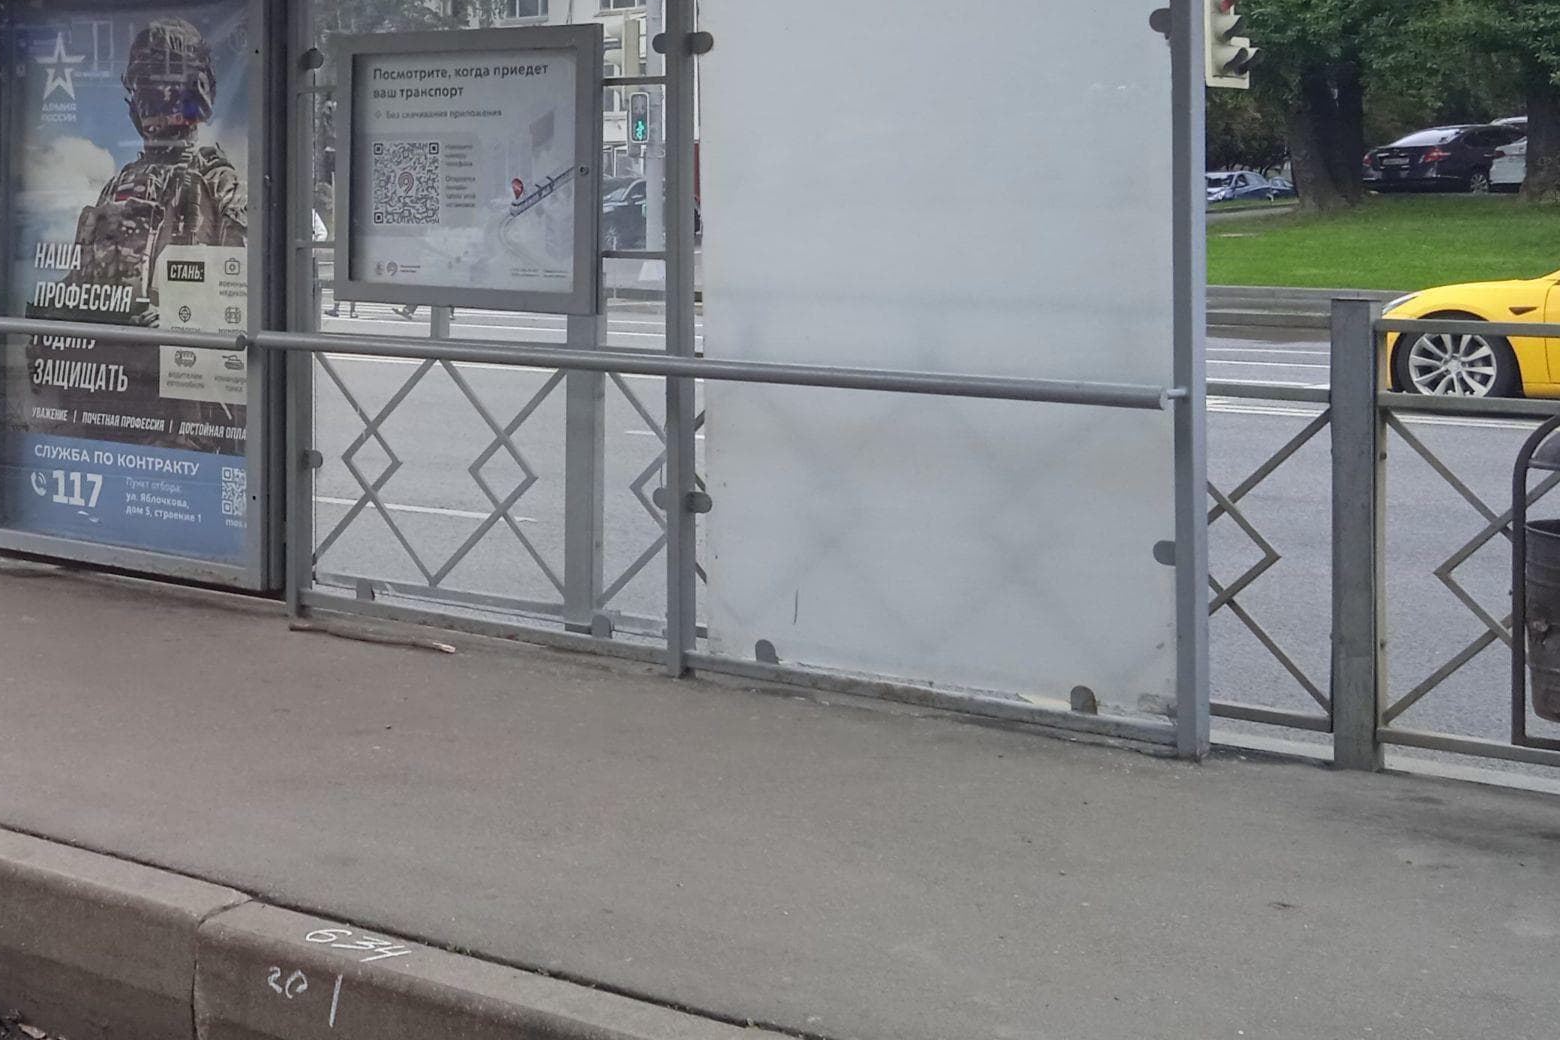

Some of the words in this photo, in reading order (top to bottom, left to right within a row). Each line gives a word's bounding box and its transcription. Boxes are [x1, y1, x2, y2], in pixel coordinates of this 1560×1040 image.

[373, 67, 452, 81] Посмотрите,
[455, 65, 490, 78] когда
[494, 64, 549, 78] приедет
[373, 89, 397, 98] ваш
[399, 86, 464, 101] транспорт
[34, 244, 82, 271] НАША
[170, 264, 203, 280] СТАНЬ:
[34, 281, 133, 313] ПРОФЕССИЯ
[33, 359, 129, 392] ЗАЩИЩАТЬ
[32, 407, 68, 422] УВАЖЕНИЕ
[82, 411, 120, 427] ПОЧЕТНАЯ
[121, 415, 165, 432] ПРОФЕССИЯ
[179, 421, 225, 438] ДОСТОЙНАЯ
[35, 444, 90, 463] СЛУЖБА
[94, 451, 114, 465] ПО
[118, 453, 200, 476] КОНТРАКТУ
[52, 469, 103, 508] 117
[126, 476, 149, 489] Пункт
[140, 493, 190, 510] Яблочкова,
[126, 505, 143, 515] дом
[145, 506, 153, 517] 5,
[154, 510, 195, 522] строение
